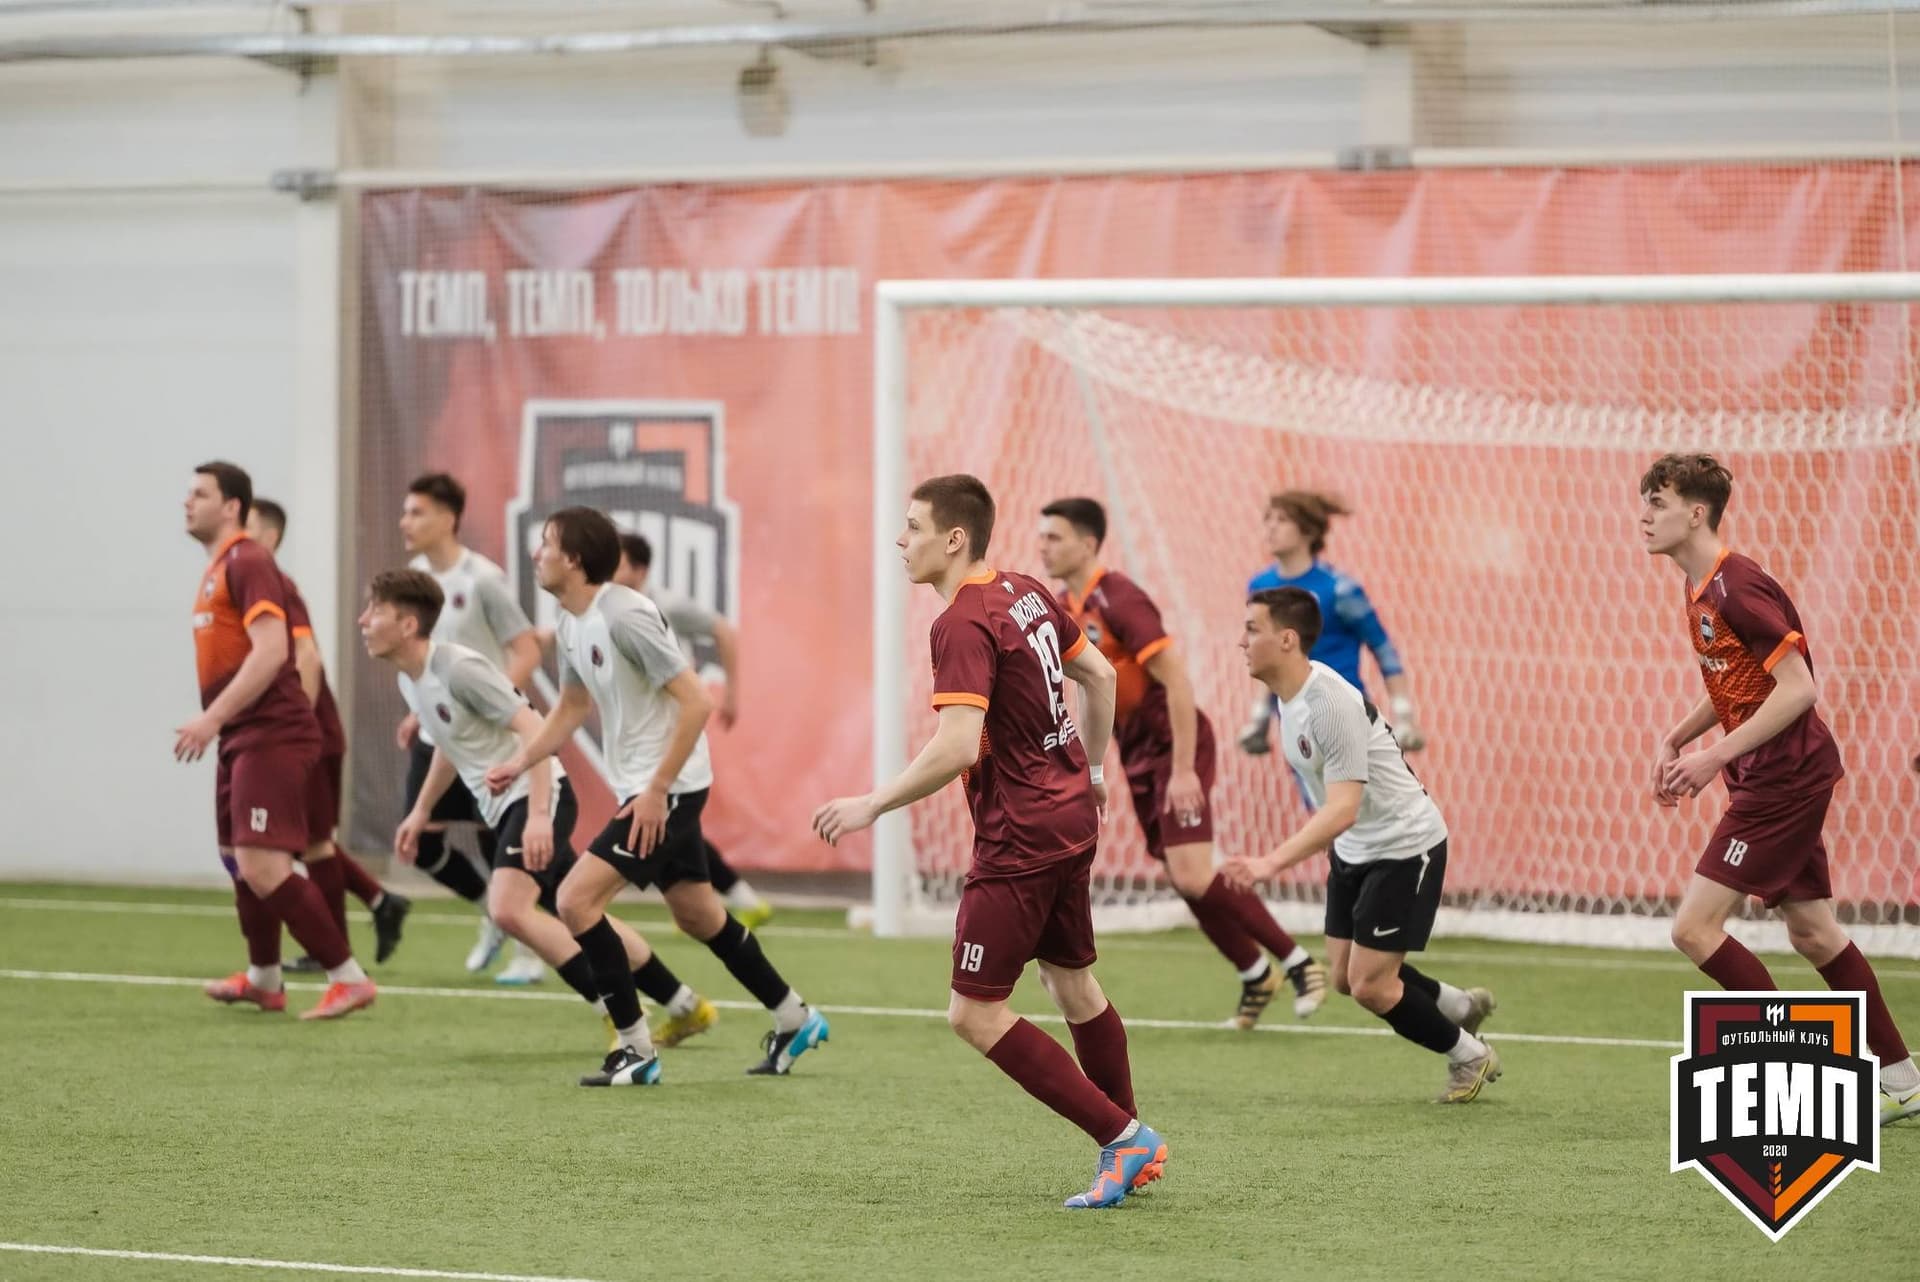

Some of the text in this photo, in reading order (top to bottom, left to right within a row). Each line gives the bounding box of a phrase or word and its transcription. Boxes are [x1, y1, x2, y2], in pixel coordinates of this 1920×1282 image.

[398, 269, 497, 342] ТЕМП,
[506, 269, 605, 342] ТЕМП,
[612, 267, 746, 335] ТОЛЬКО
[1723, 838, 1749, 867] 18
[960, 941, 985, 973] 19
